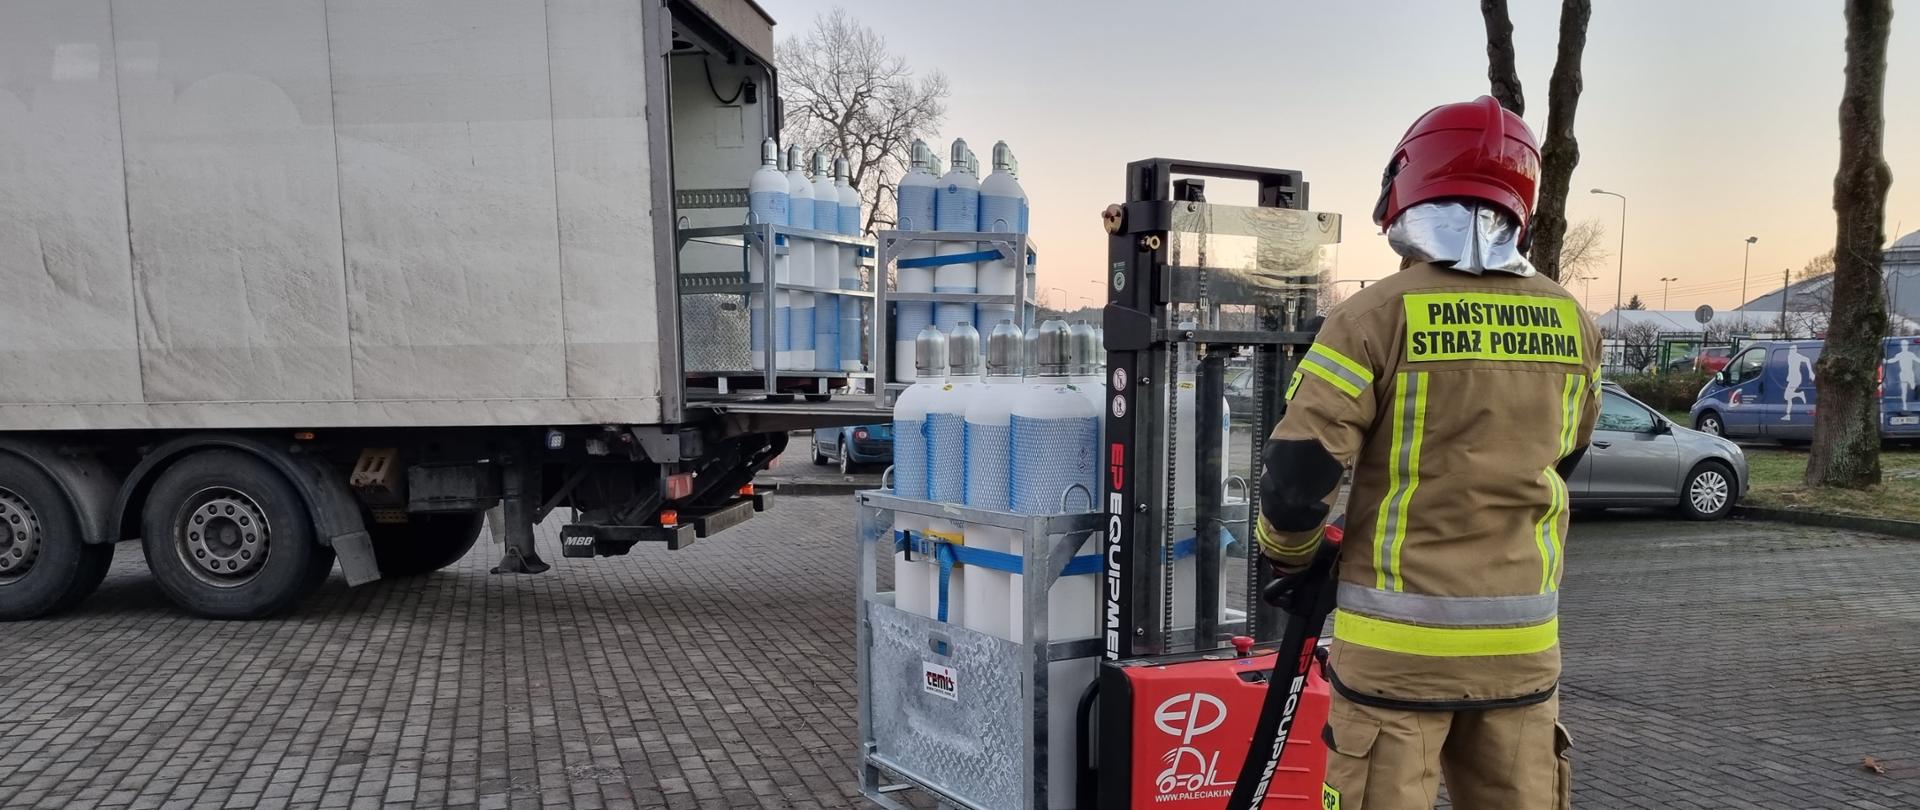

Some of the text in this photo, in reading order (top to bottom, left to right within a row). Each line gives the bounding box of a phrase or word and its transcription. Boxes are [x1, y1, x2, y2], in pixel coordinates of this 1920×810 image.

[1428, 299, 1562, 329] PAŃSTWOWA
[1412, 330, 1579, 358] STRAŻ POŻARNA
[1111, 443, 1125, 490] EP
[564, 536, 593, 546] MBB
[1297, 637, 1318, 674] EP
[1154, 692, 1228, 745] EP
[1155, 788, 1234, 802] WWW.PALECIAKI.IN
